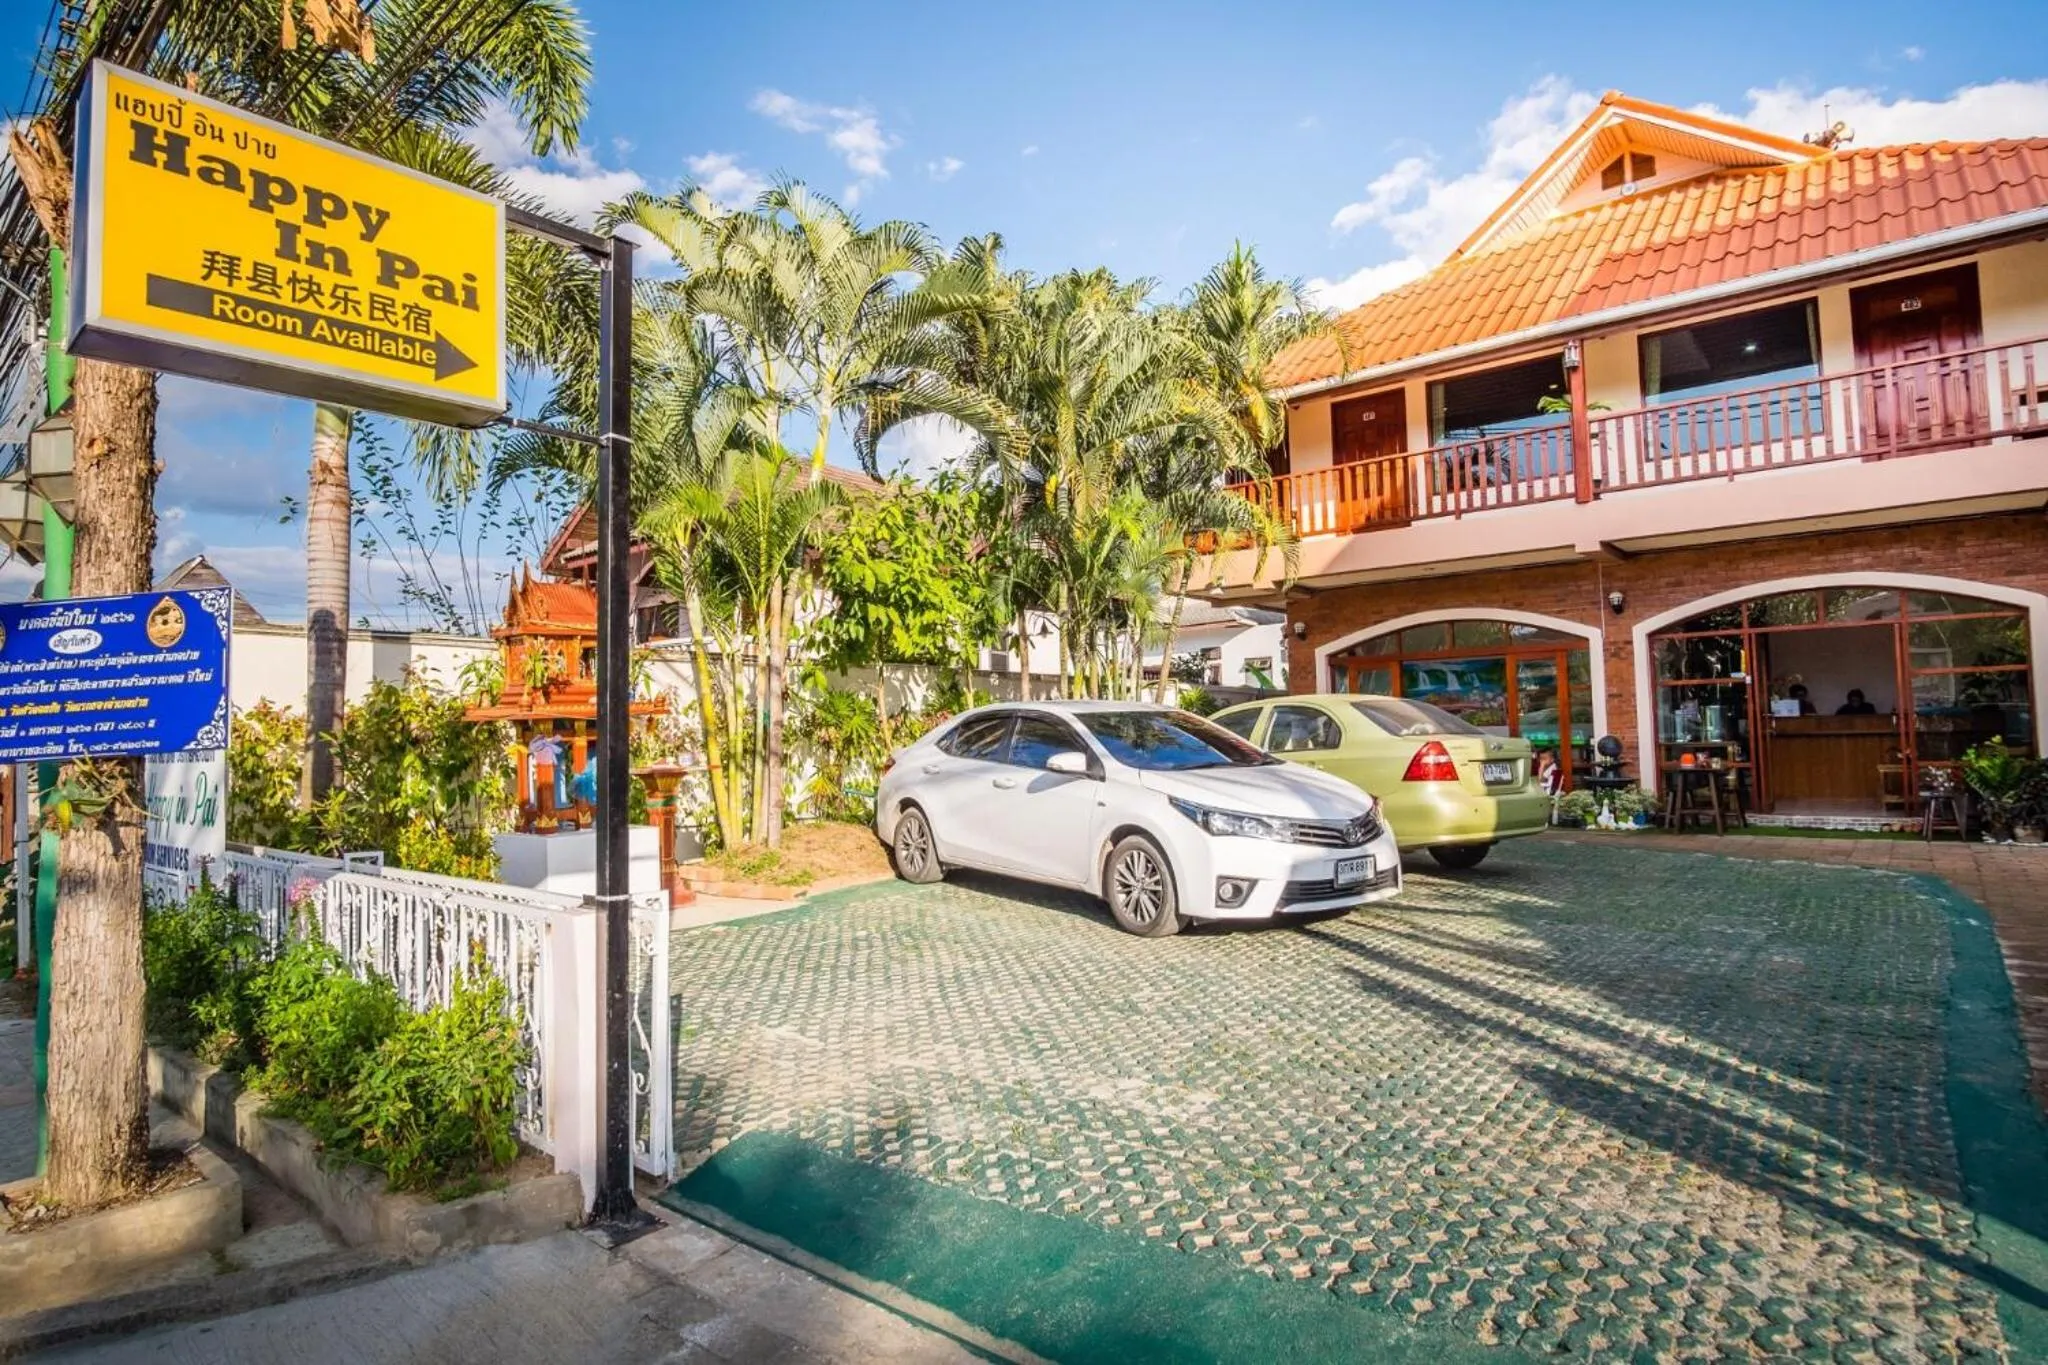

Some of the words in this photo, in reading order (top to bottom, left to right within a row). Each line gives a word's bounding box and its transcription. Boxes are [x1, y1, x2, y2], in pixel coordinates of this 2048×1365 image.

[115, 92, 185, 128] แฮปปี้
[193, 112, 224, 143] อิน
[233, 130, 278, 160] ปาย
[129, 119, 390, 242] Happy
[200, 249, 433, 336] 拜县快乐民宿
[274, 218, 352, 278] In
[376, 248, 480, 313] Pai
[213, 294, 302, 335] Room
[311, 318, 437, 367] Available
